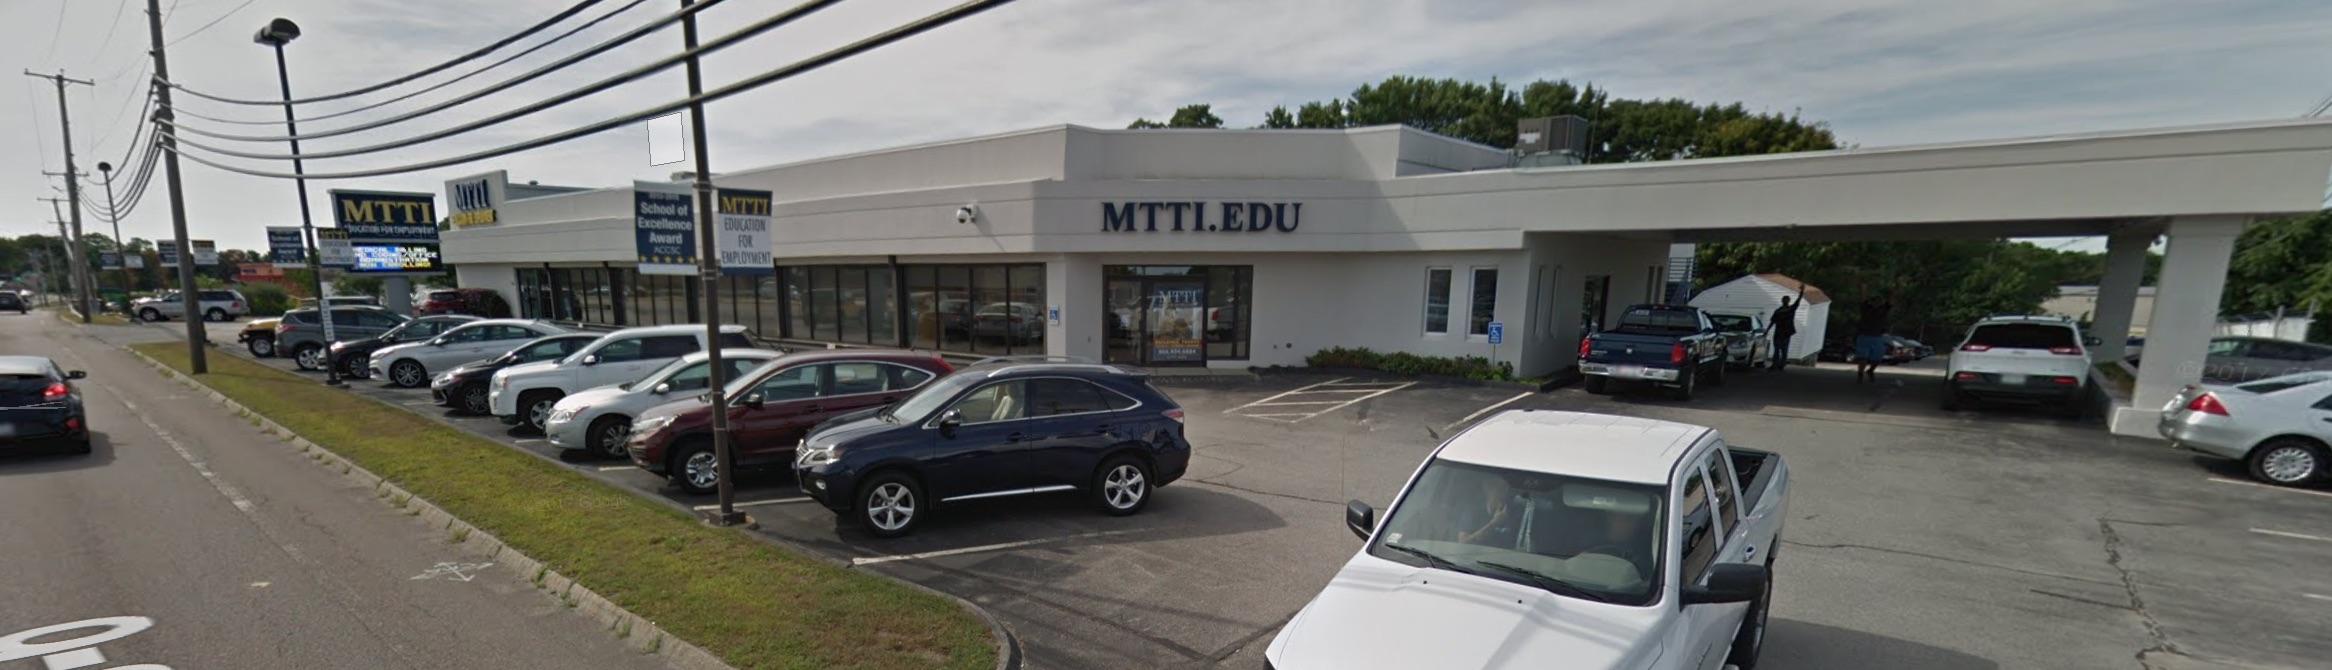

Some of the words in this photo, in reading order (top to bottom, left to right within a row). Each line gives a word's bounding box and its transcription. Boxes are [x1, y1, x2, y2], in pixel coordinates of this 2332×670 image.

[341, 200, 433, 224] MTTI
[640, 202, 676, 215] School
[677, 204, 689, 216] of
[722, 197, 769, 214] MTTI
[638, 217, 692, 231] Excellence
[1101, 201, 1303, 233] MTTI.EDU
[724, 217, 766, 232] EDUCATION
[649, 232, 683, 245] Award
[738, 234, 753, 248] FOR
[722, 251, 771, 264] EMPLOYMENT
